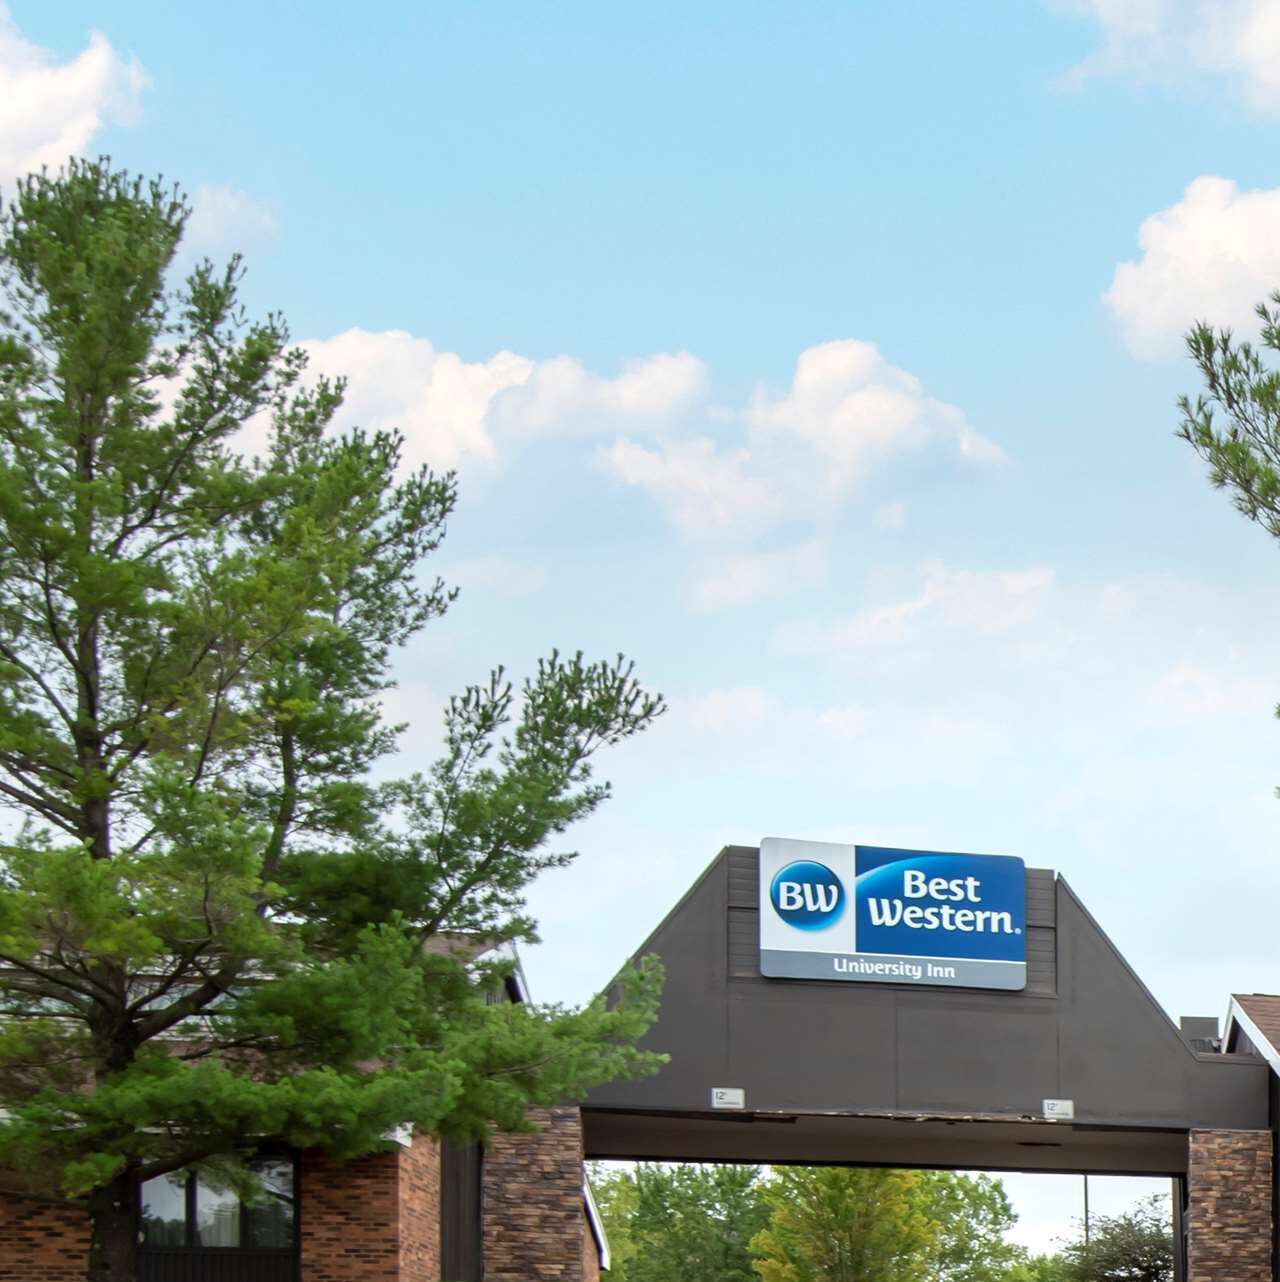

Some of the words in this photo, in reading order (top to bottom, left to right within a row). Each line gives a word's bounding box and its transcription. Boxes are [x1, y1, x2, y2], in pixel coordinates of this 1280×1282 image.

[779, 881, 838, 912] BW
[904, 870, 981, 902] Best
[833, 958, 923, 979] University
[927, 963, 956, 978] Inn
